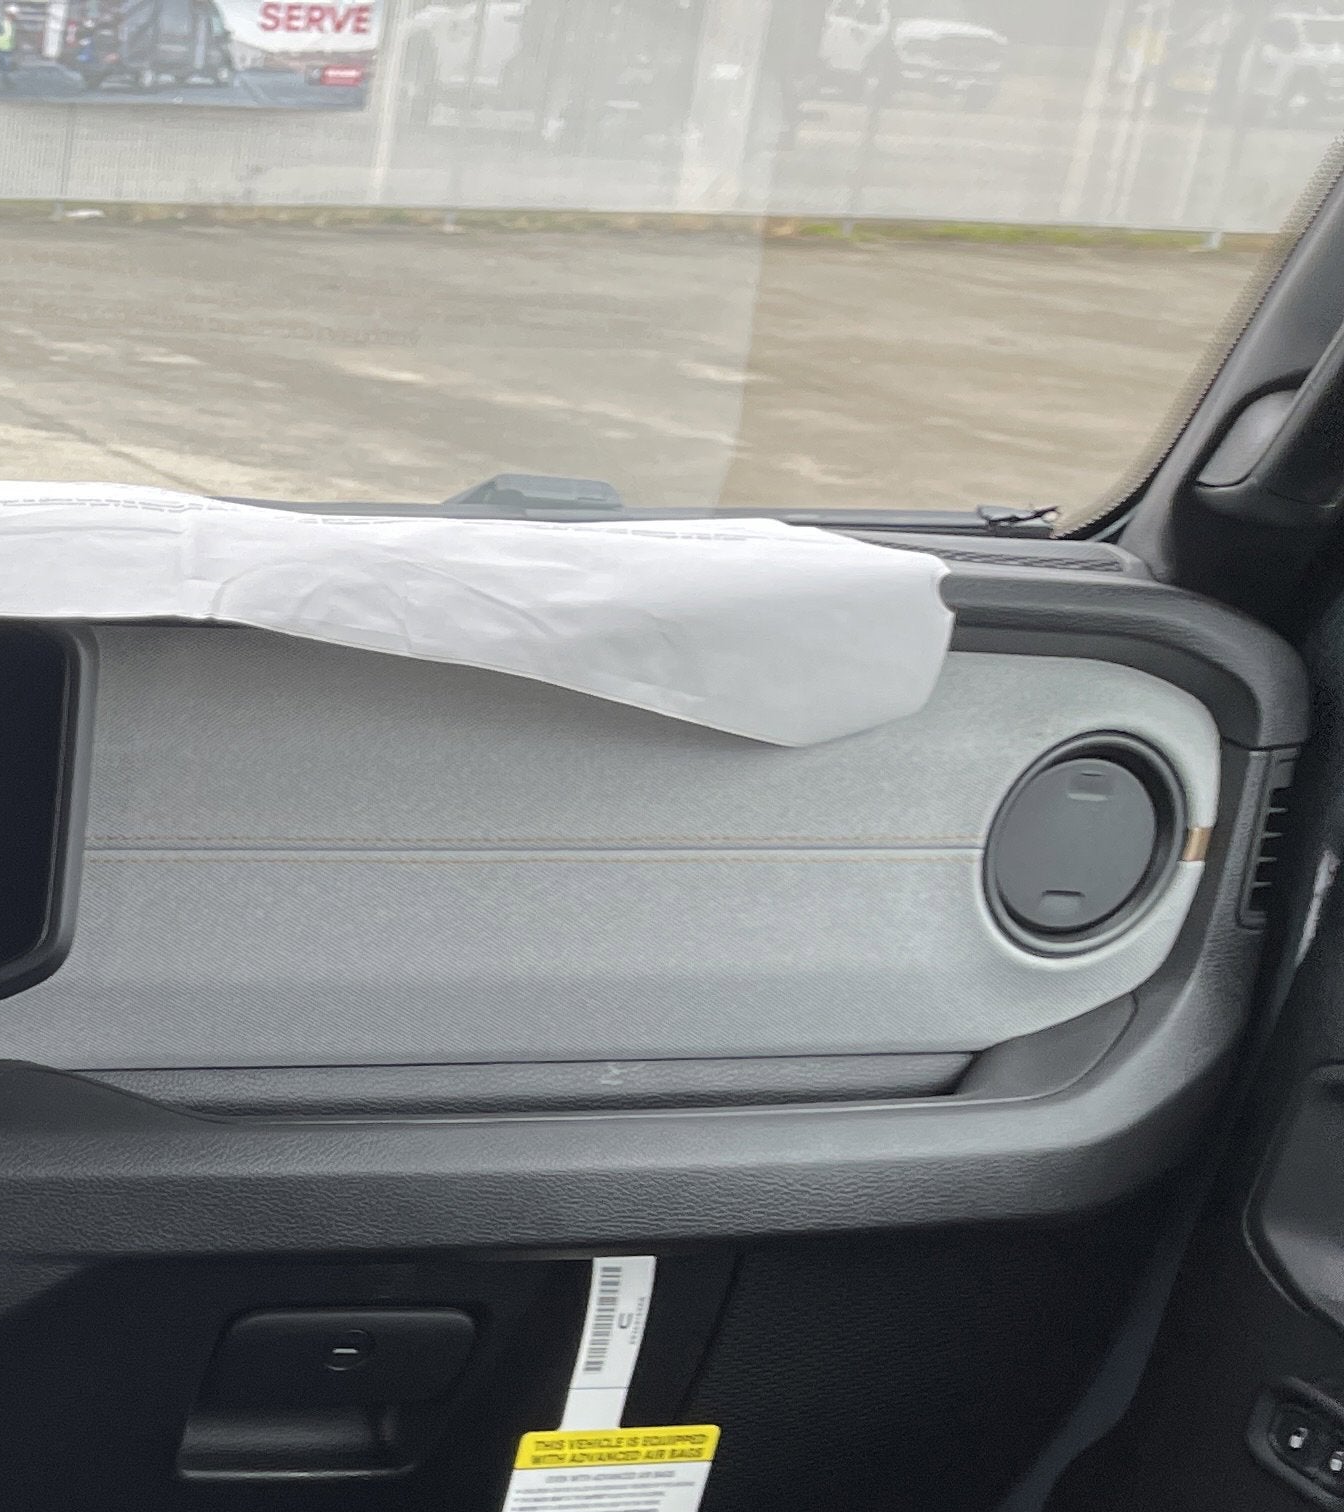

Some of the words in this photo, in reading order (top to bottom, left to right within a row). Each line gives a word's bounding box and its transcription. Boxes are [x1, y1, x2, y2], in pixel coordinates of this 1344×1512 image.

[259, 2, 370, 34] SERVE
[568, 1437, 623, 1449] VEHICLE
[568, 1450, 641, 1463] ADVANCED
[644, 1448, 666, 1459] AIR
